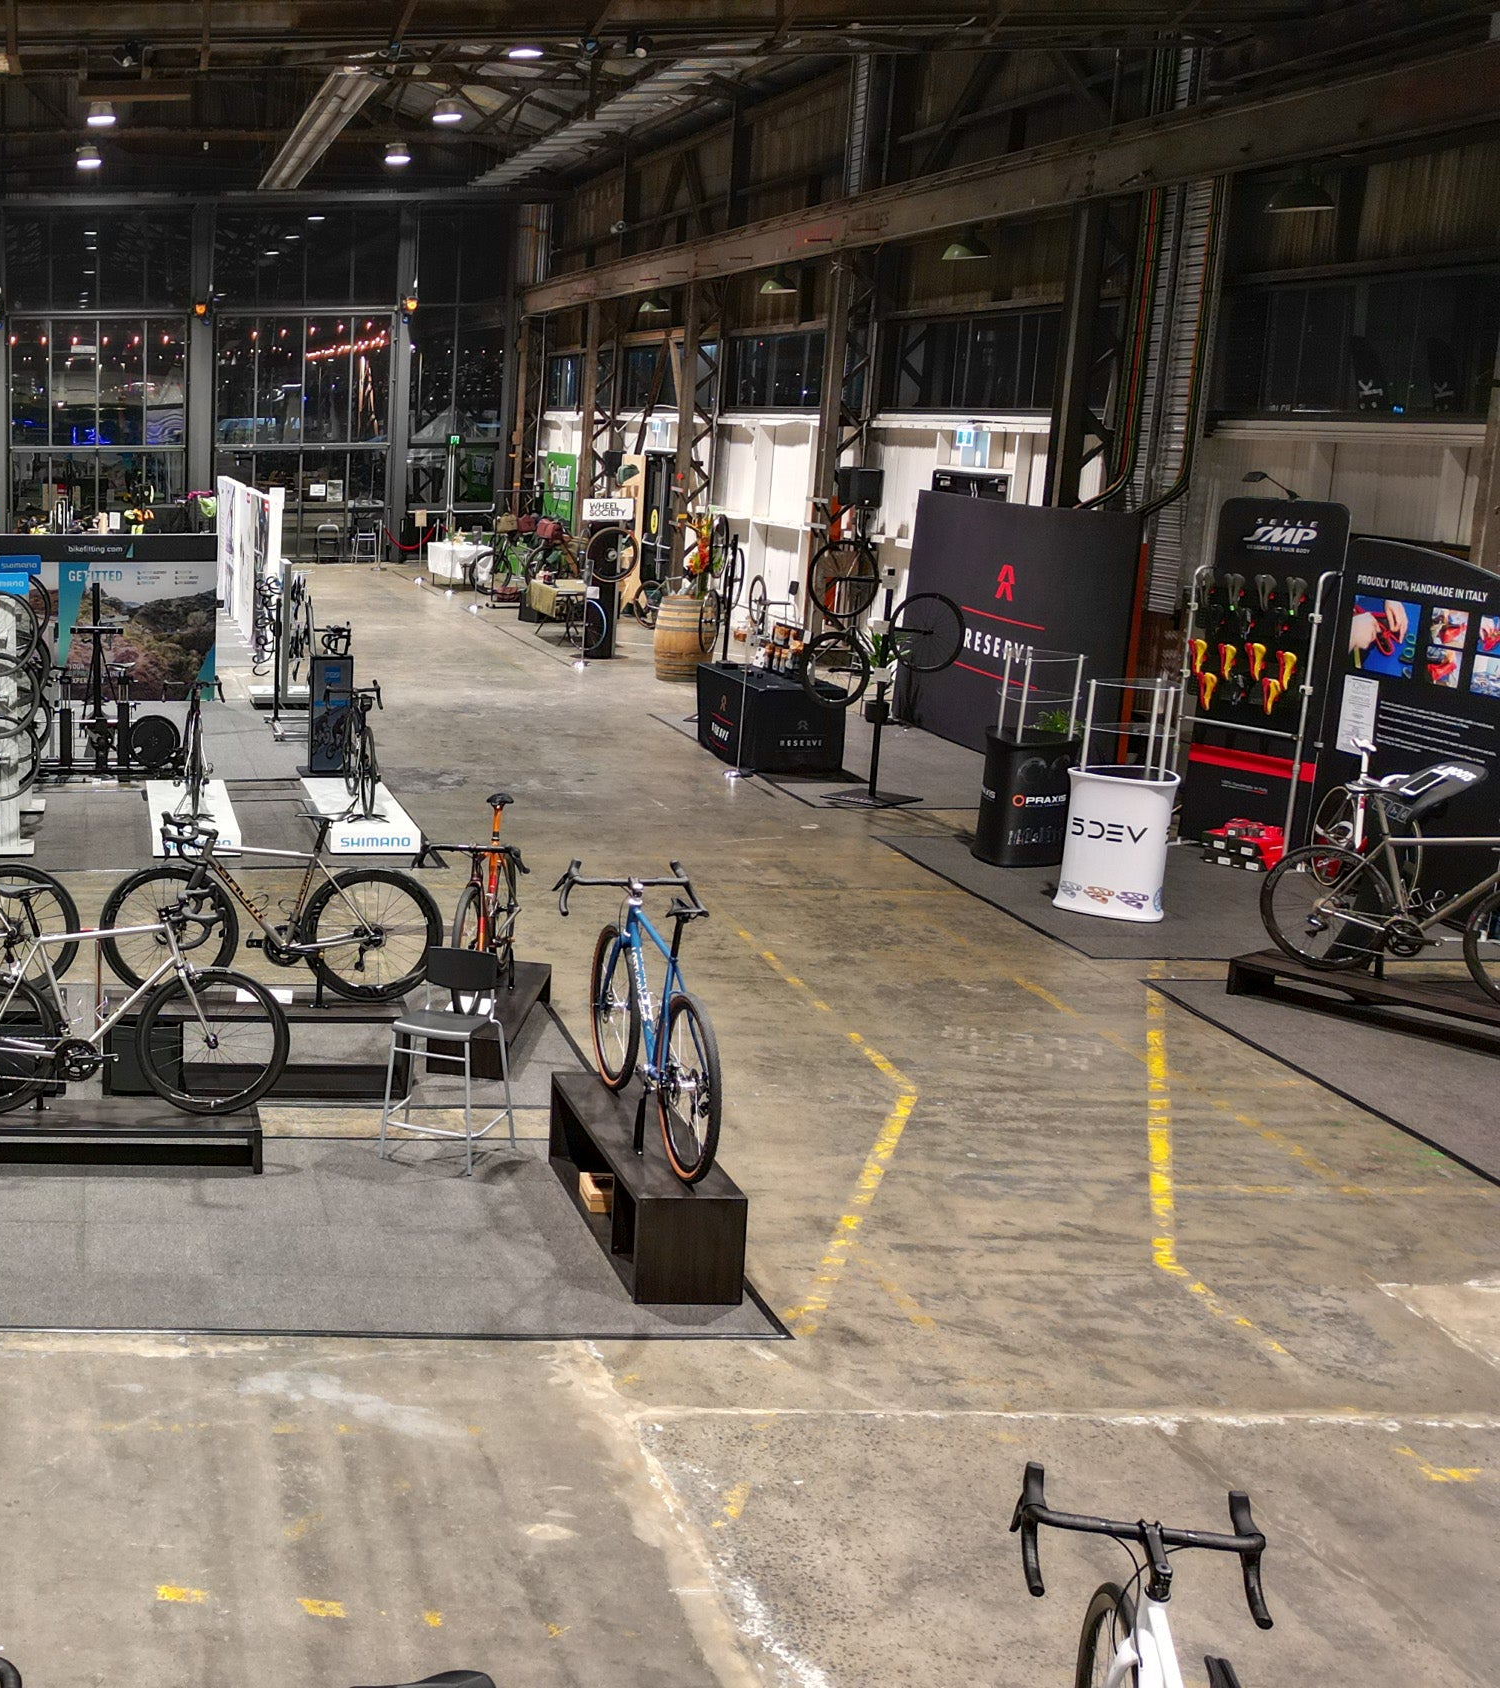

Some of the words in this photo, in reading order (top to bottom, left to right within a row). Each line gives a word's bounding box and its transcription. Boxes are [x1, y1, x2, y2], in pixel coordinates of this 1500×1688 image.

[589, 509, 627, 517] SOCIETY
[1256, 517, 1319, 528] SELLE
[1242, 526, 1317, 545] SMP
[68, 545, 123, 554] bikefitting.com
[1, 561, 38, 569] SHIMANO
[1356, 574, 1390, 589] PROUDLY
[1390, 579, 1409, 592] 100%
[1410, 582, 1454, 598] HANDMADE
[1454, 588, 1464, 599] IN
[1465, 589, 1488, 602] ITALY
[963, 627, 1034, 667] RESERVE
[1026, 794, 1067, 805] PRAXIS
[1071, 816, 1148, 844] 5DEV
[340, 836, 411, 848] SHIMANO
